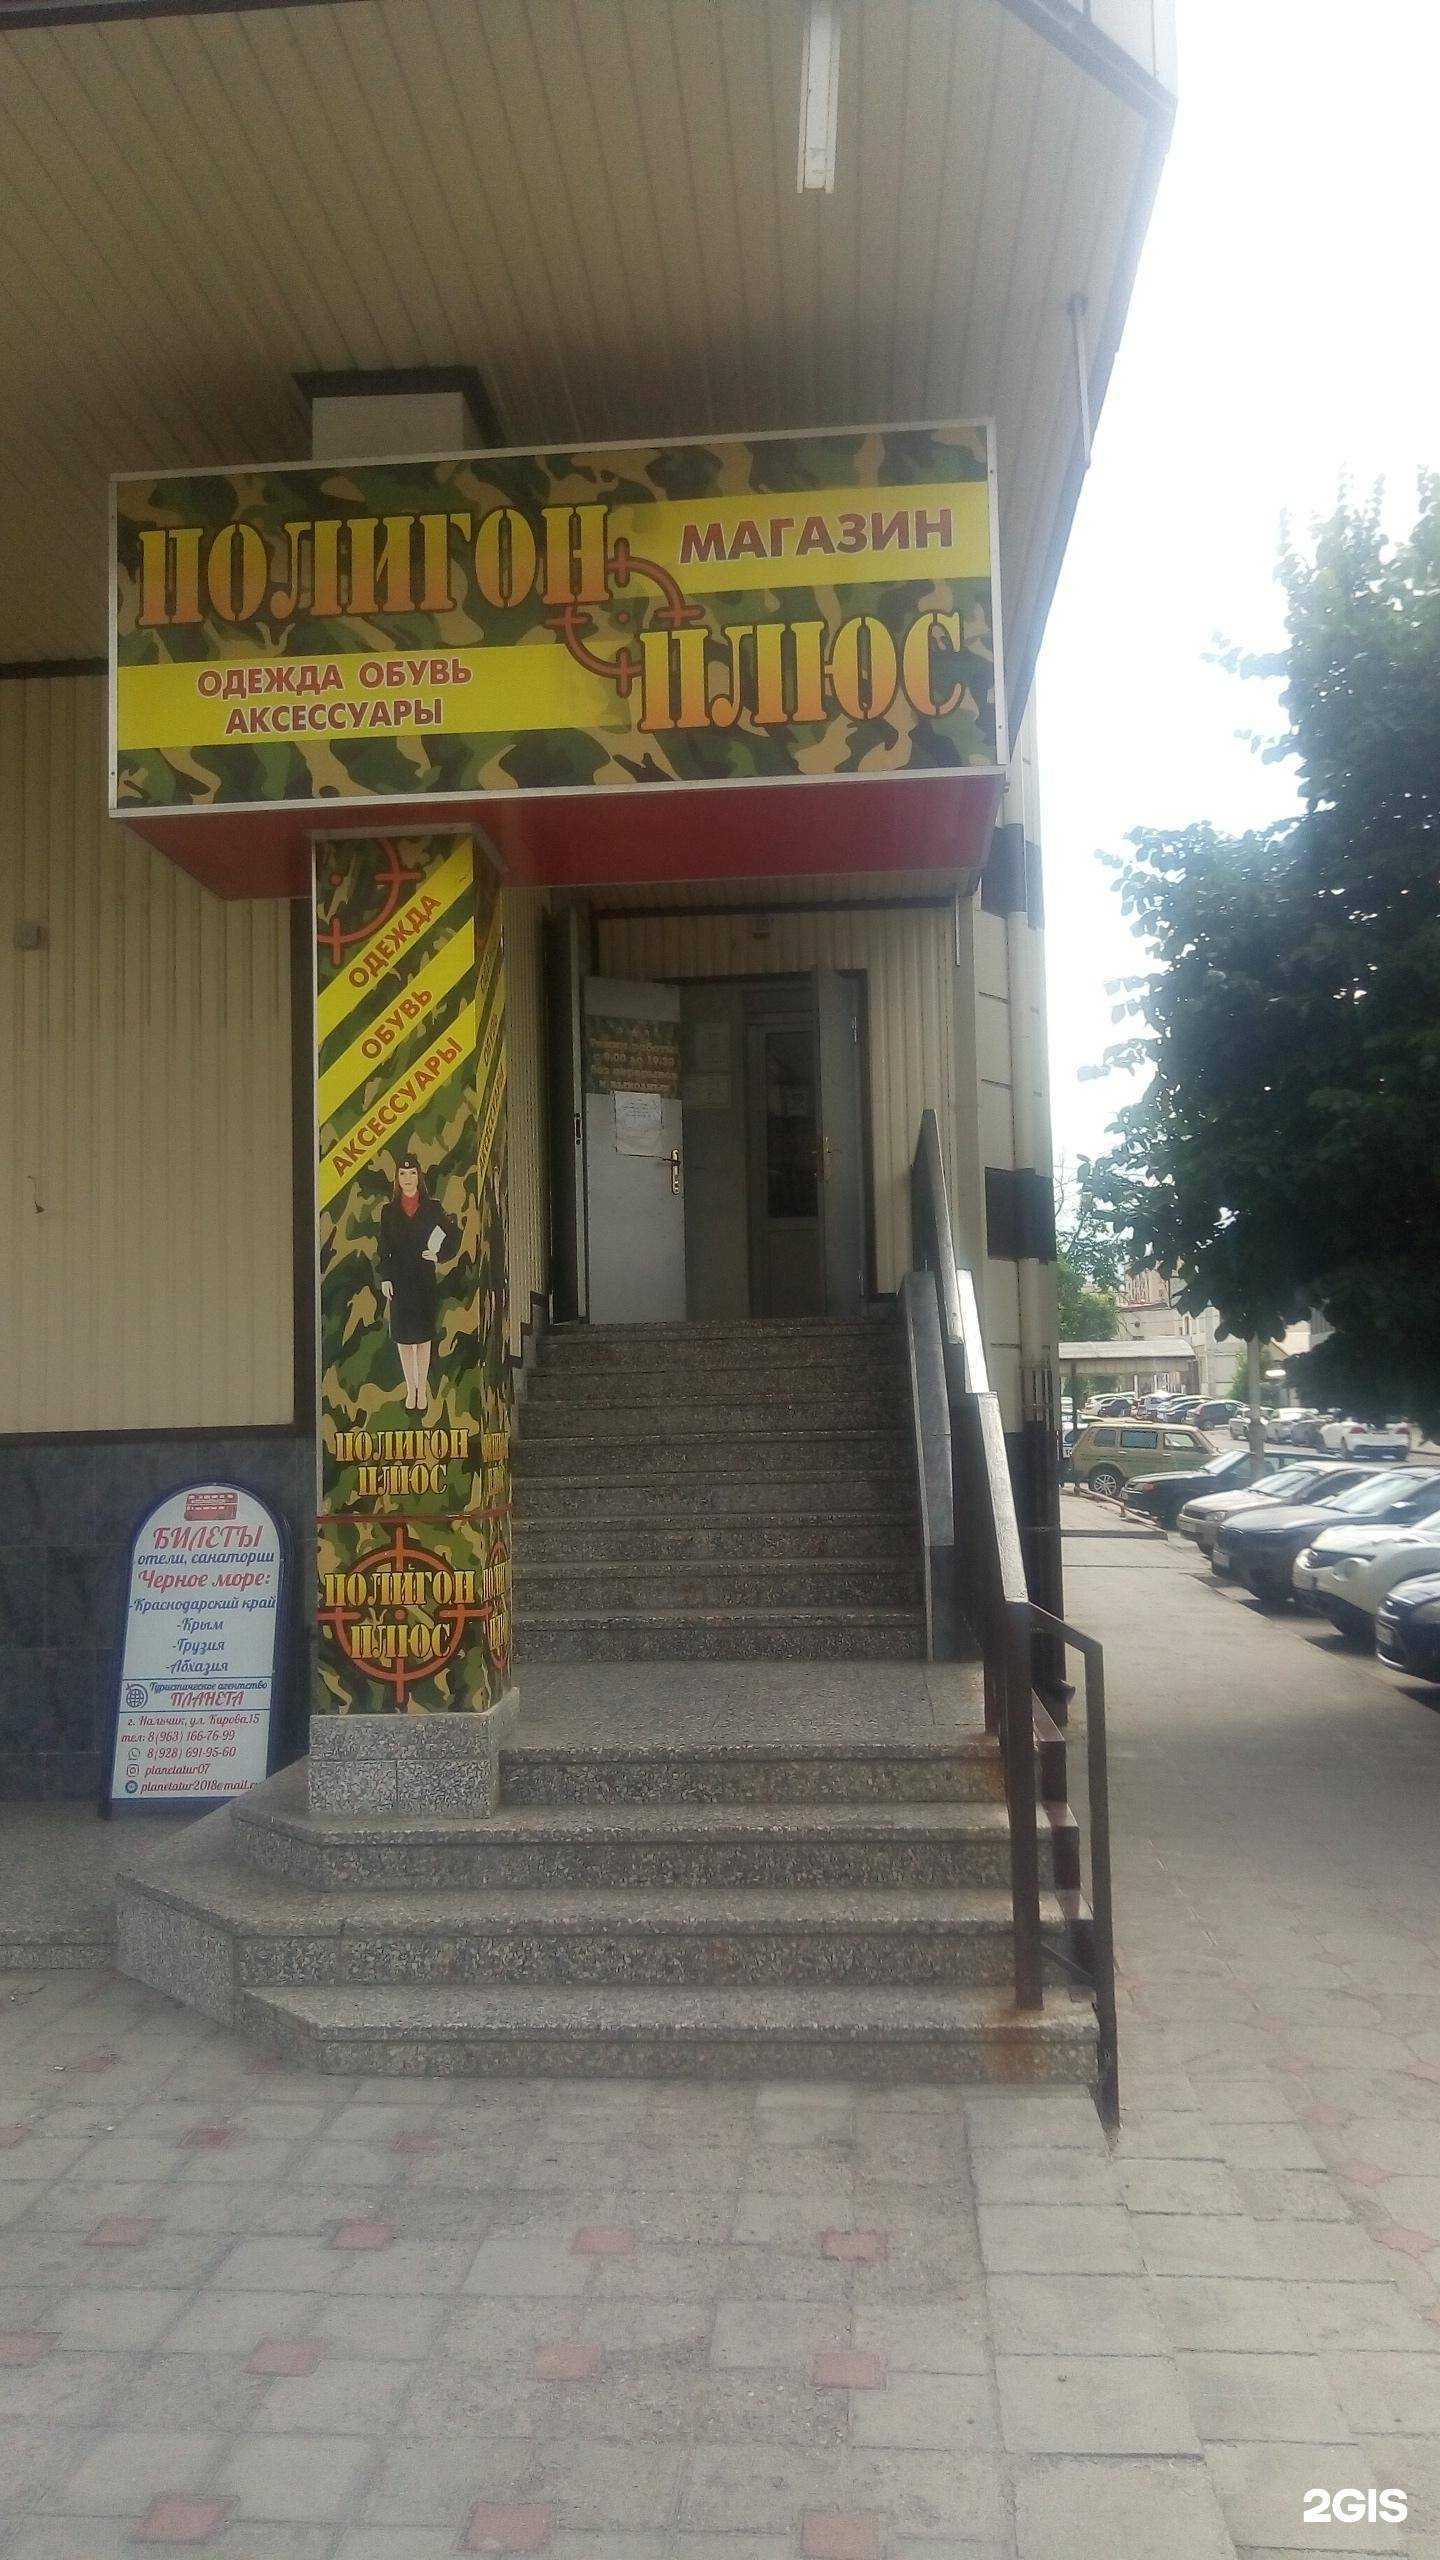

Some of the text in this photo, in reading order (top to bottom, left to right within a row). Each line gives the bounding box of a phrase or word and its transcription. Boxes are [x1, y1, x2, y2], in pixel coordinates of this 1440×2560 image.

[679, 508, 953, 564] МАГАЗИН
[138, 504, 612, 629] ПОЛИГОН
[197, 658, 473, 700] ОДЕЖДА ОБУВЬ
[638, 610, 966, 733] ПЛЮС
[225, 698, 443, 736] АКСЕССУАРЫ
[348, 894, 442, 988] ОДЕЖДА
[361, 988, 433, 1060] ОБУВЬ
[331, 1036, 464, 1177] АКСЕССУАРЫ
[335, 1428, 470, 1462] ПОЛИГОН
[358, 1463, 448, 1496] ПЛЮС
[153, 1525, 264, 1550] БИЛЕТЫ
[138, 1551, 274, 1566] отели, санатории
[138, 1569, 271, 1593] Черное море:
[324, 1570, 476, 1607] ПОЛИГОН
[241, 1595, 277, 1611] край
[350, 1623, 452, 1659] ПЛЮС
[171, 1690, 245, 1708] ПЛАНЕТА
[218, 1680, 268, 1691] агентство
[140, 1780, 257, 1794] planetatur2018@mail.r
